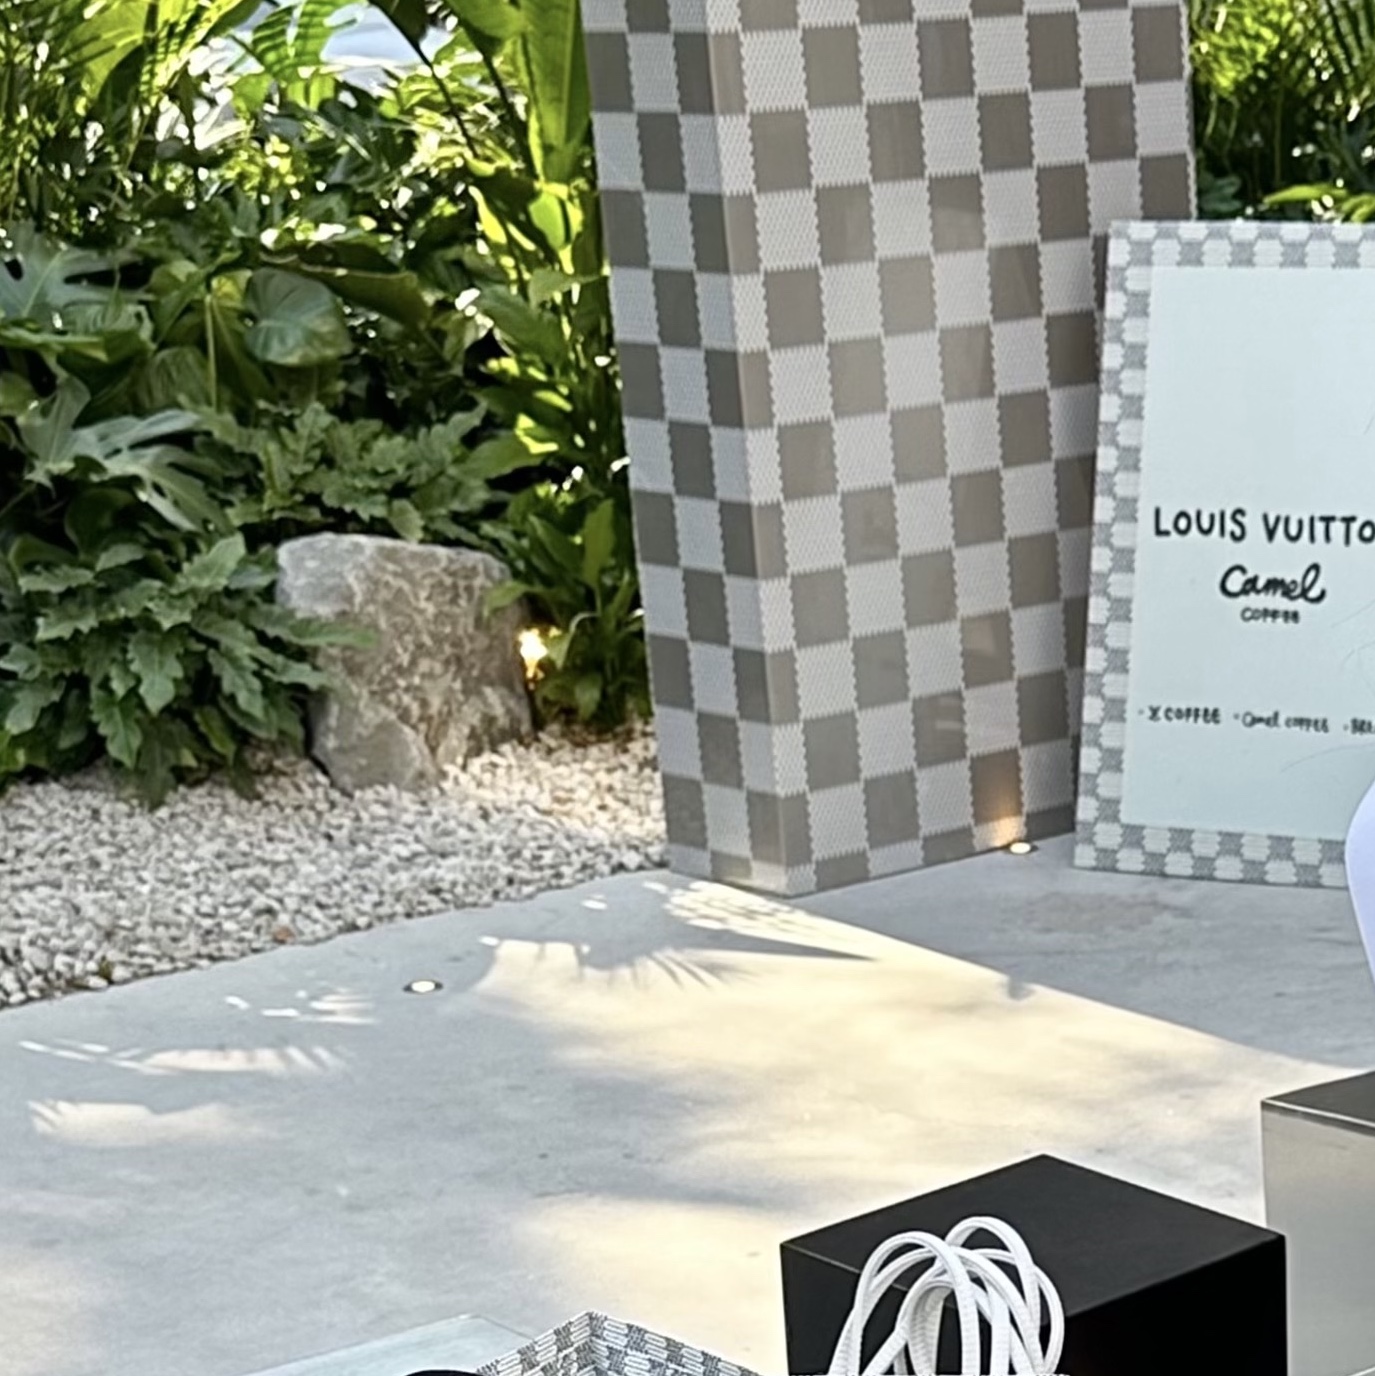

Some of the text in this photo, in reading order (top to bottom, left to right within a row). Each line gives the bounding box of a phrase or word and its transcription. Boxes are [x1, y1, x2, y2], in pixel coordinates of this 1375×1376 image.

[1154, 506, 1247, 543] LOUIS
[1219, 562, 1326, 603] Camel
[1164, 707, 1221, 724] COFFEE
